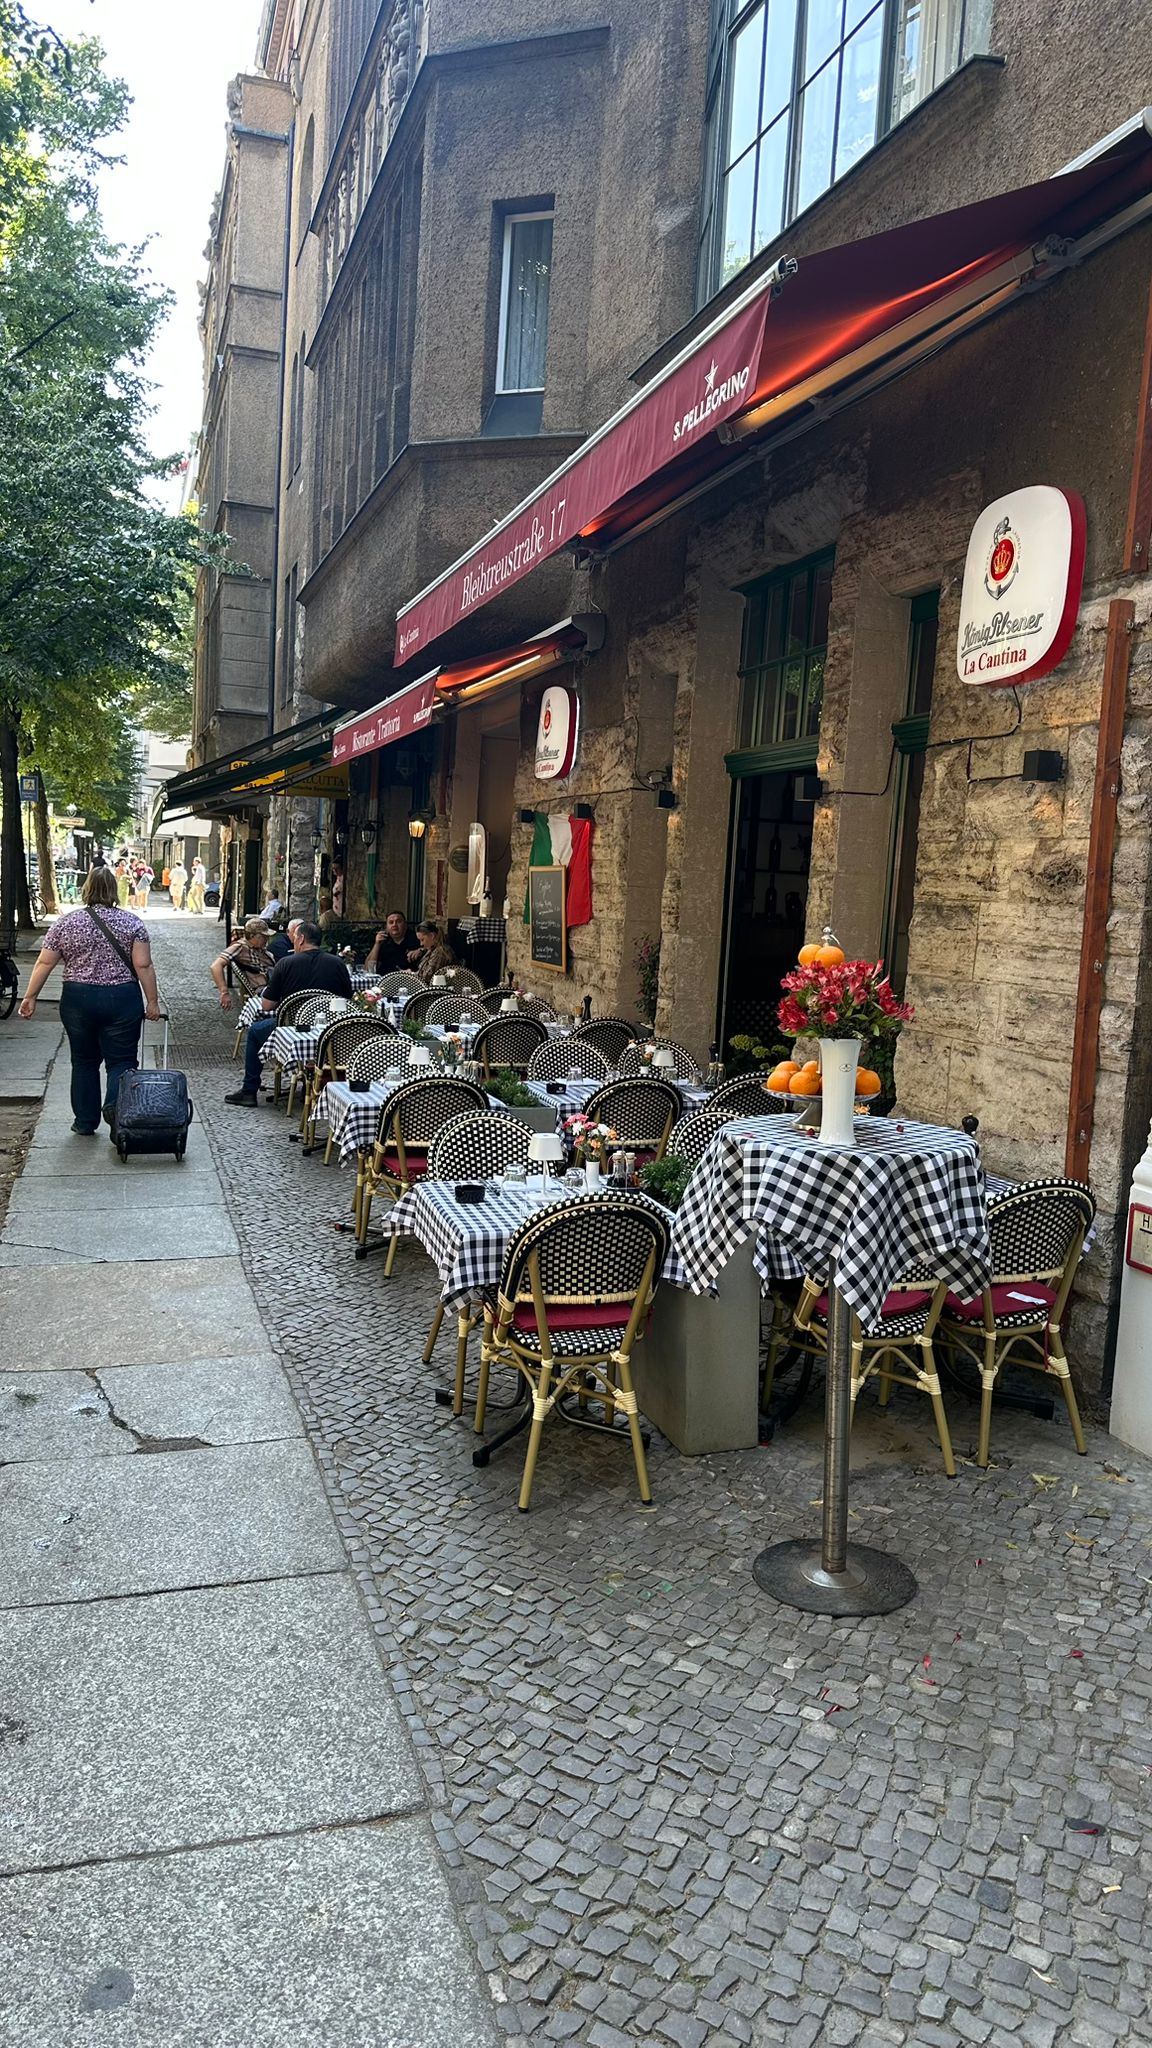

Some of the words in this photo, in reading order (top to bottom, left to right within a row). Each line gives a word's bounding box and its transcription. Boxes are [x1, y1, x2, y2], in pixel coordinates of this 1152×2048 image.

[460, 516, 545, 611] Bleibtreustraße
[548, 498, 567, 543] 17
[963, 658, 976, 676] La
[978, 646, 1027, 671] Cantina
[377, 708, 401, 741] Trattoria
[1142, 1214, 1151, 1229] H
